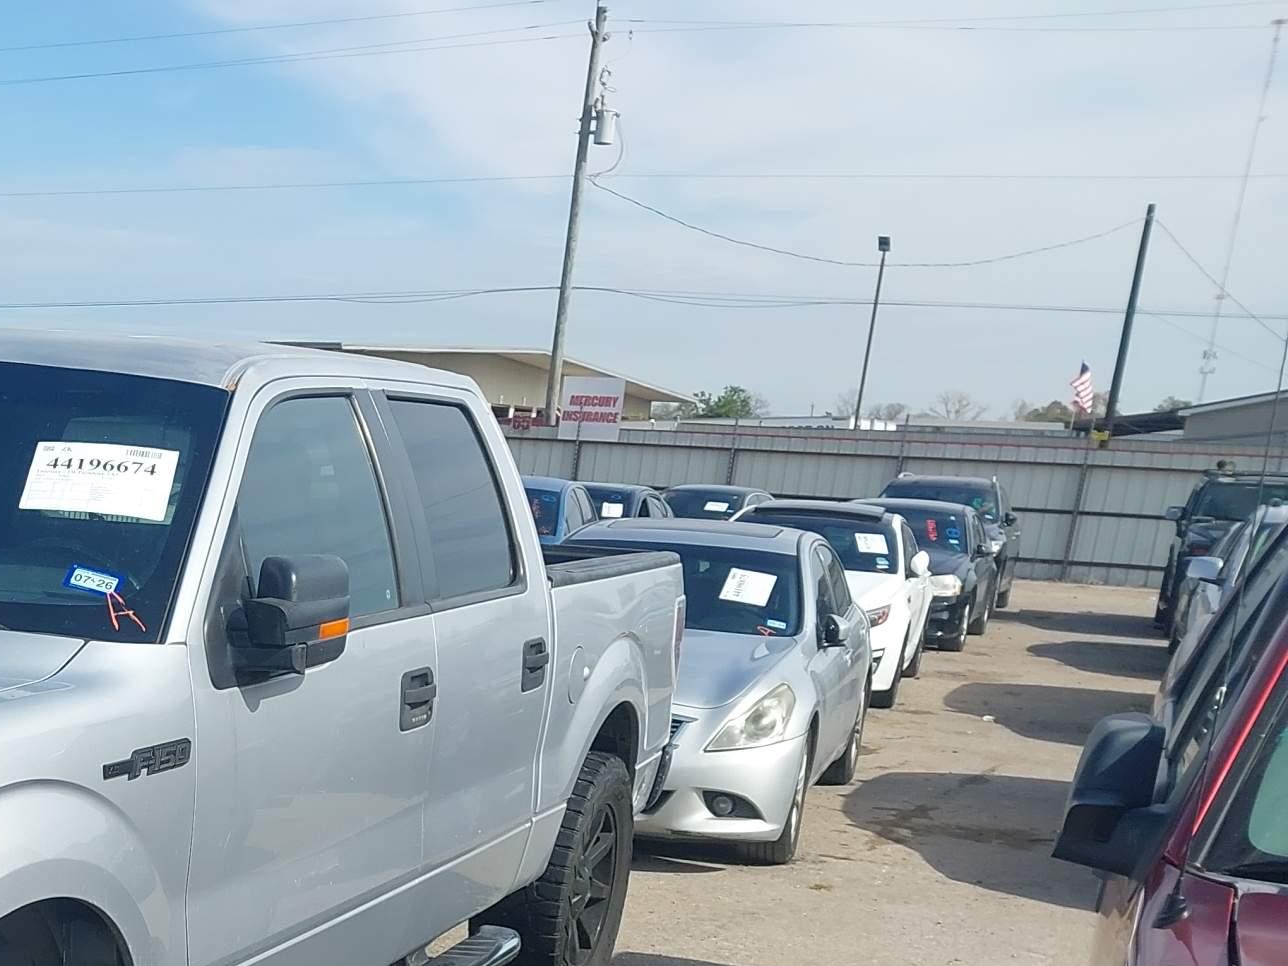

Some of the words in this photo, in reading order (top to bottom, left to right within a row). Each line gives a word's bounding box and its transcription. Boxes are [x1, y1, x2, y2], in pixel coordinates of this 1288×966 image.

[569, 395, 619, 407] MERCURY
[561, 410, 619, 423] INSURANCE
[45, 456, 158, 476] 44196674
[128, 738, 191, 781] F-150
